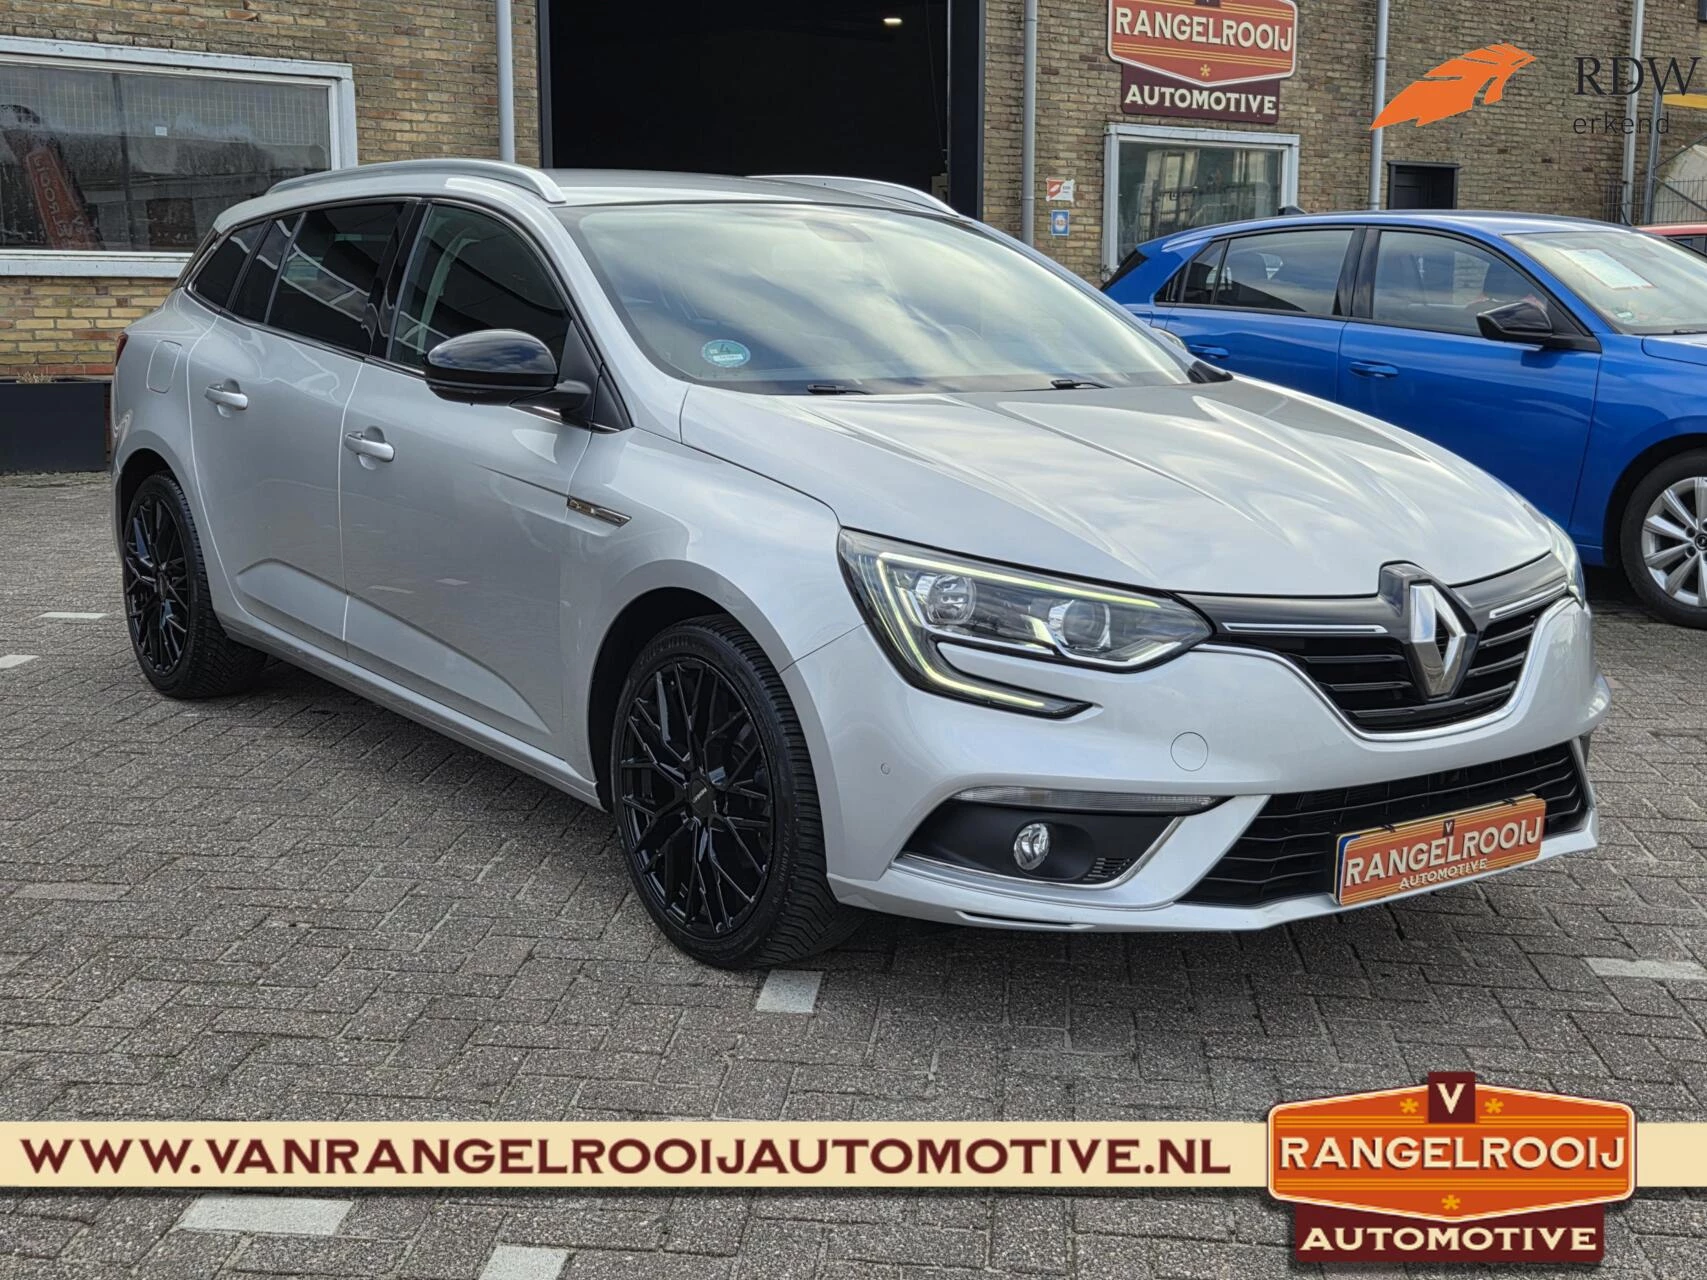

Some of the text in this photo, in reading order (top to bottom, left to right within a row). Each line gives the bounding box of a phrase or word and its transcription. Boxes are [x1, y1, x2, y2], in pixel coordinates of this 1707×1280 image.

[1115, 7, 1293, 51] RANGELROOIJ
[1124, 84, 1278, 115] AUTOMOTIVE
[1445, 820, 1454, 834] V
[1344, 816, 1542, 888] RANGELROOIJ
[1399, 858, 1488, 890] AUTOMOTIVE
